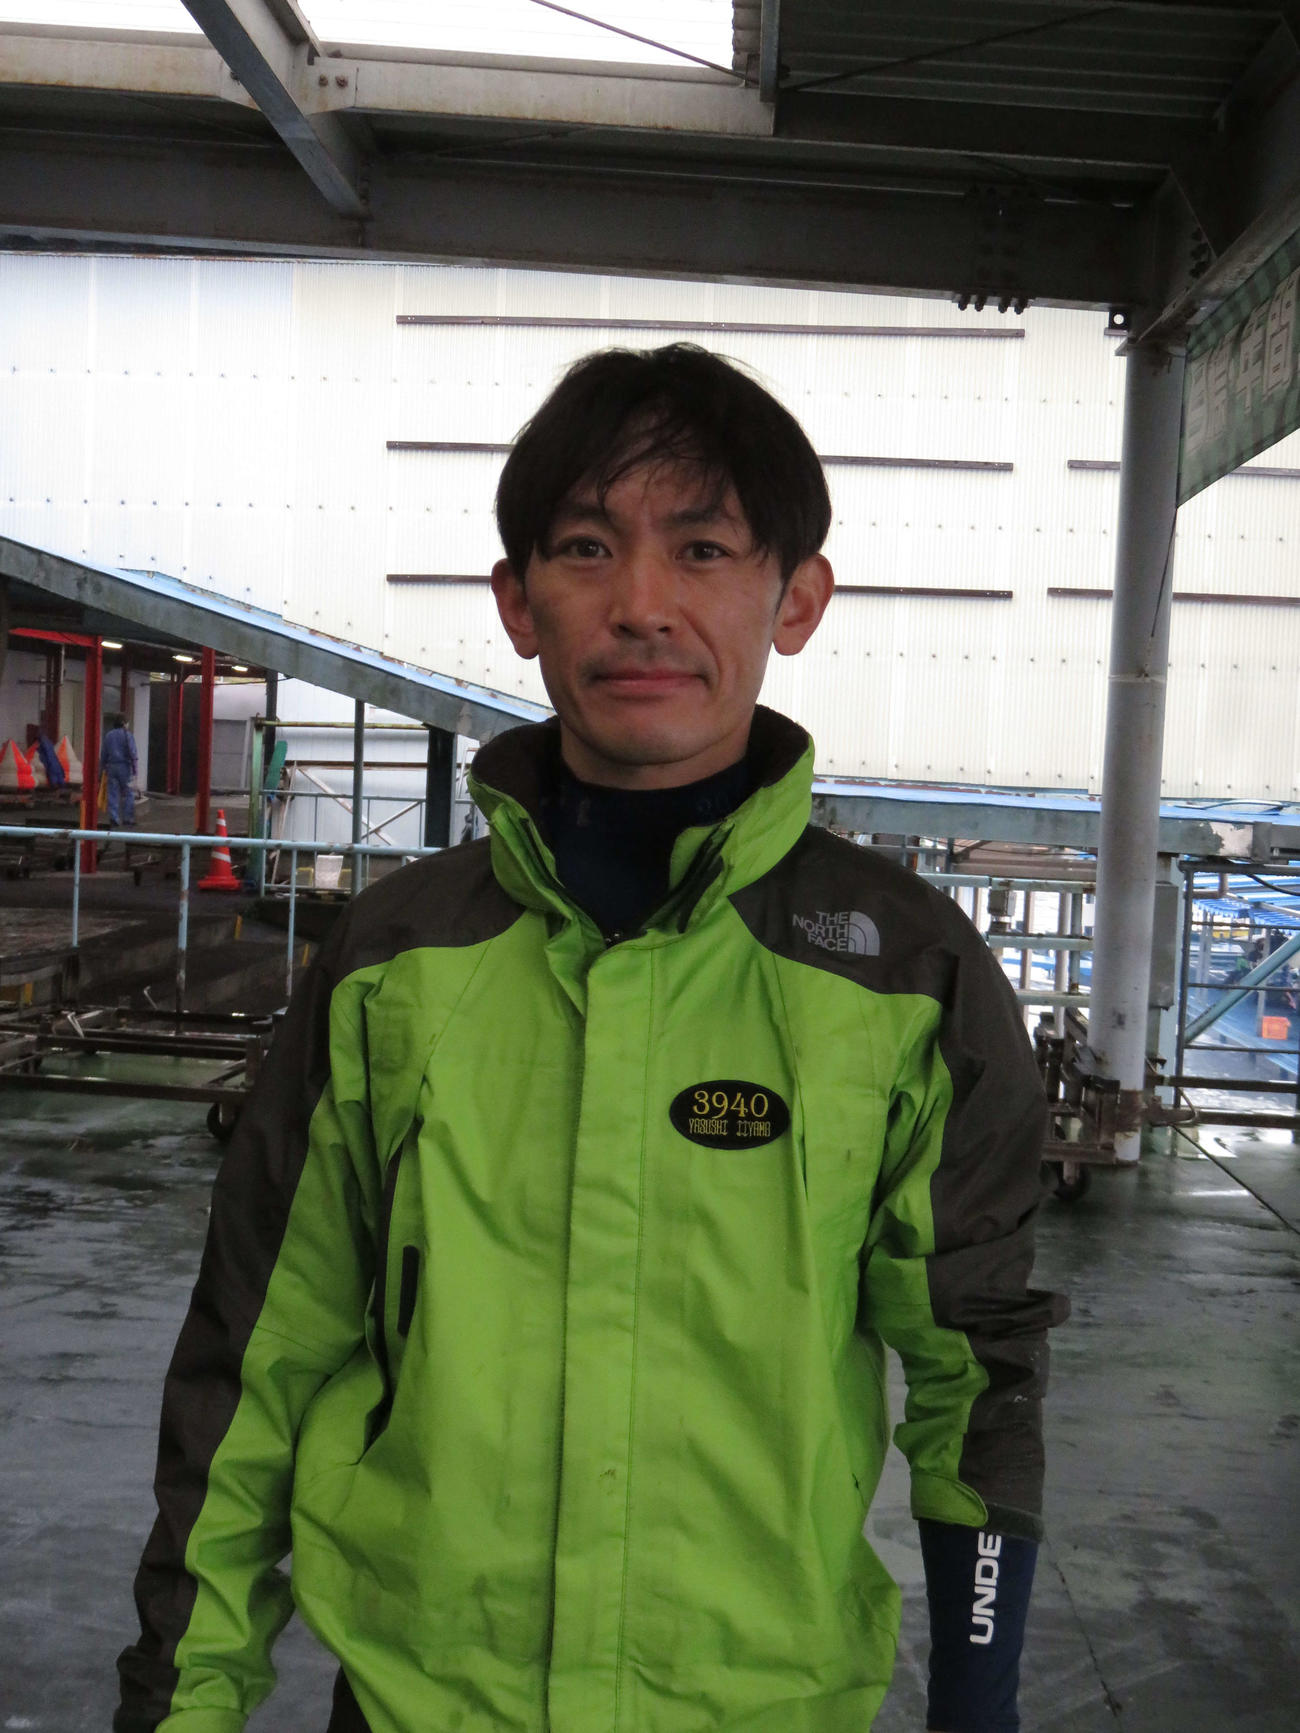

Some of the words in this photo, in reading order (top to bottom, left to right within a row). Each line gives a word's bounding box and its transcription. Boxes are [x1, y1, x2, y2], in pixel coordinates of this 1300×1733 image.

[793, 914, 849, 938] NORTH
[816, 911, 848, 924] THE
[807, 932, 848, 951] FACE
[693, 1091, 768, 1118] 3940
[689, 1118, 728, 1135] YASUSHI
[969, 1531, 1002, 1644] UNDE
